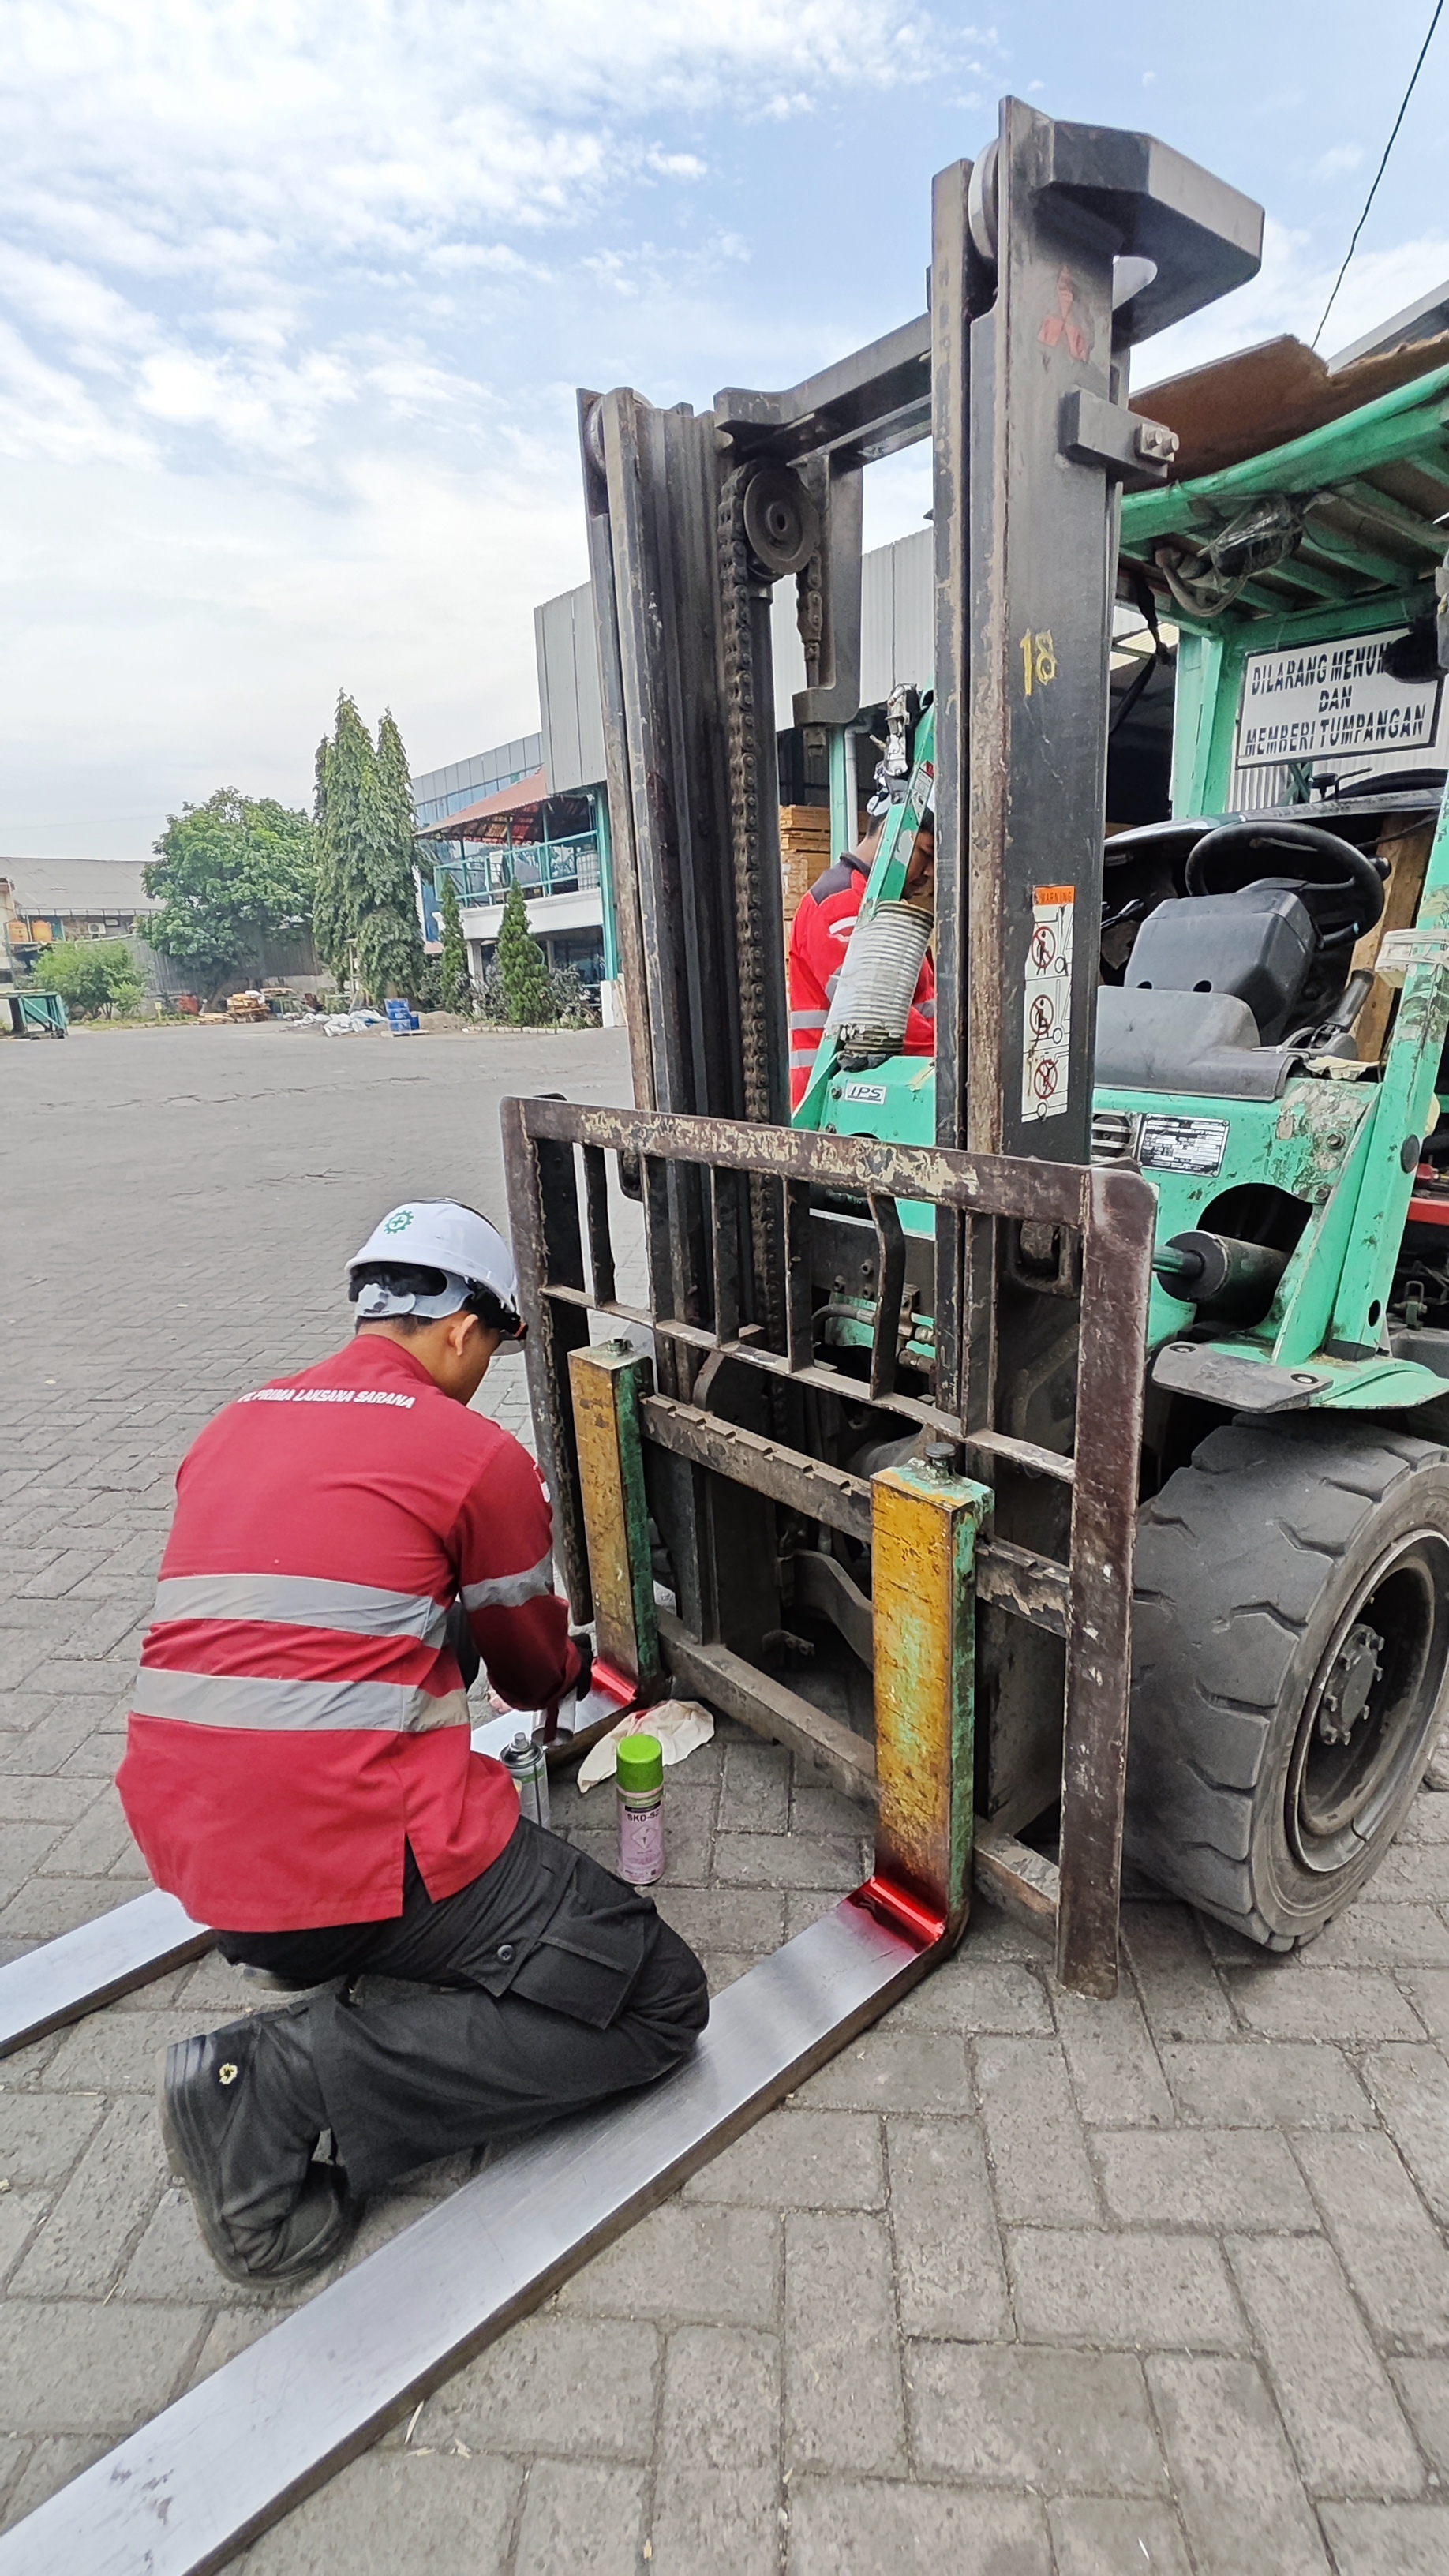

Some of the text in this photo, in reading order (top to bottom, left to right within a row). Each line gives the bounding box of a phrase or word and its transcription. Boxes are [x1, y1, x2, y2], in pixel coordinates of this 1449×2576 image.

[1020, 628, 1058, 696] 18
[1252, 653, 1327, 695] DILARANG
[1318, 685, 1353, 713] DAN
[1245, 703, 1426, 756] MEMBERI TUMPANGAN
[851, 1086, 883, 1099] IPS
[353, 1391, 416, 1409] SARANA
